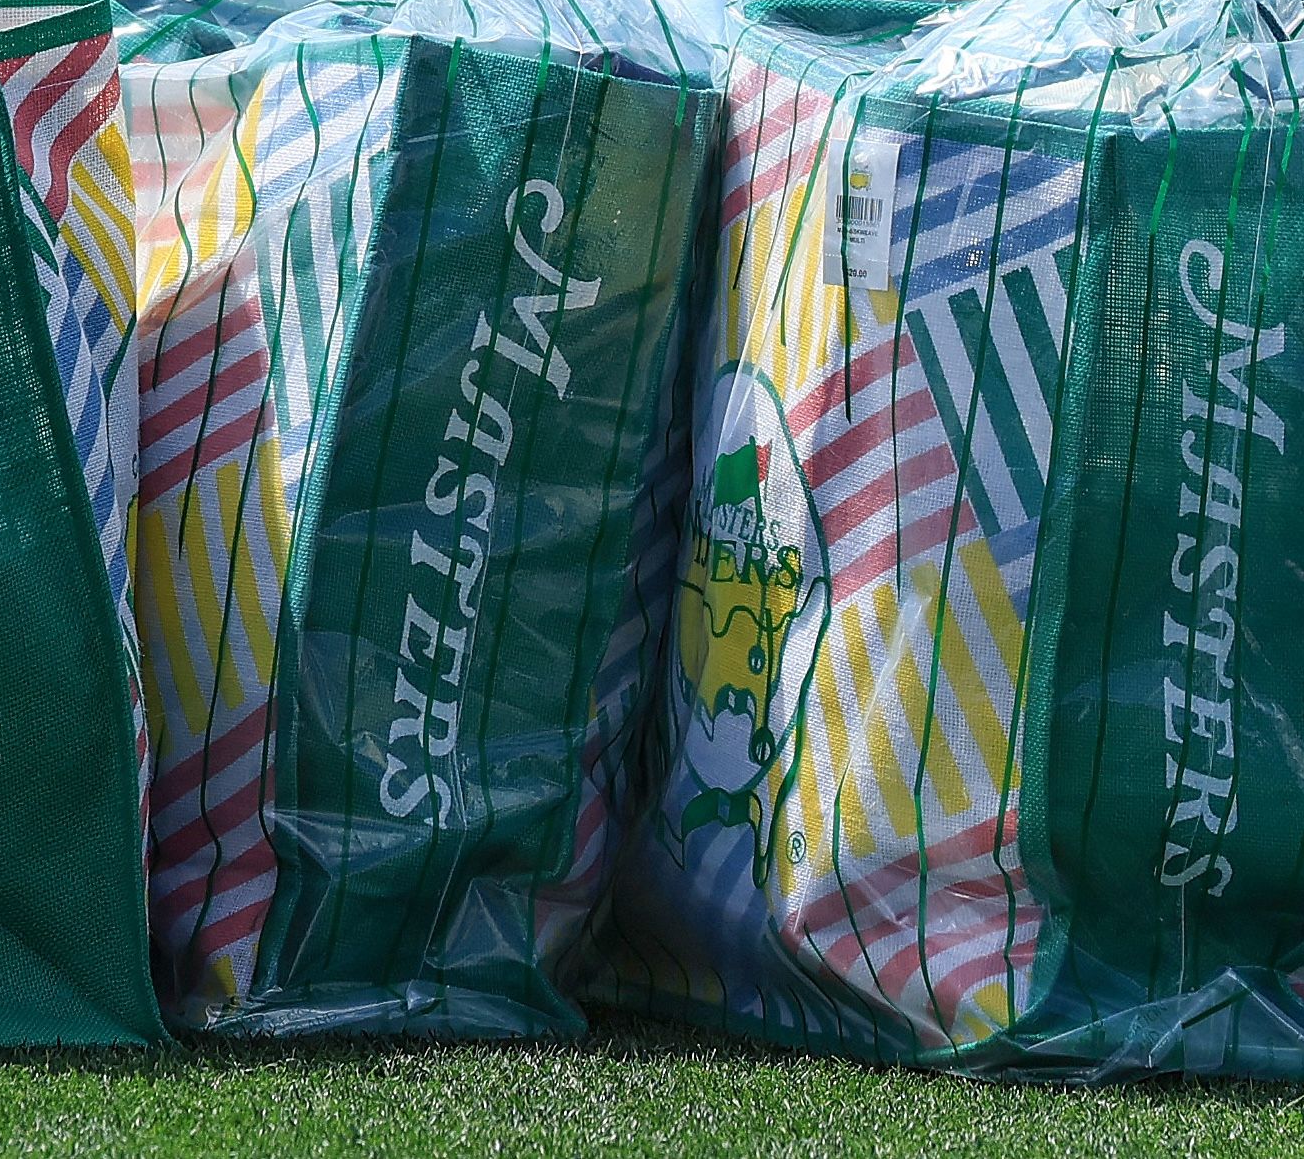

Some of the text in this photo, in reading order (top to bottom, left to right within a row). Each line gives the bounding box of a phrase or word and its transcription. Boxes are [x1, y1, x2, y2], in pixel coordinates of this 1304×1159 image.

[379, 177, 602, 831] MASTERS
[847, 268, 868, 278] 20.00
[1160, 239, 1286, 897] MASTERS
